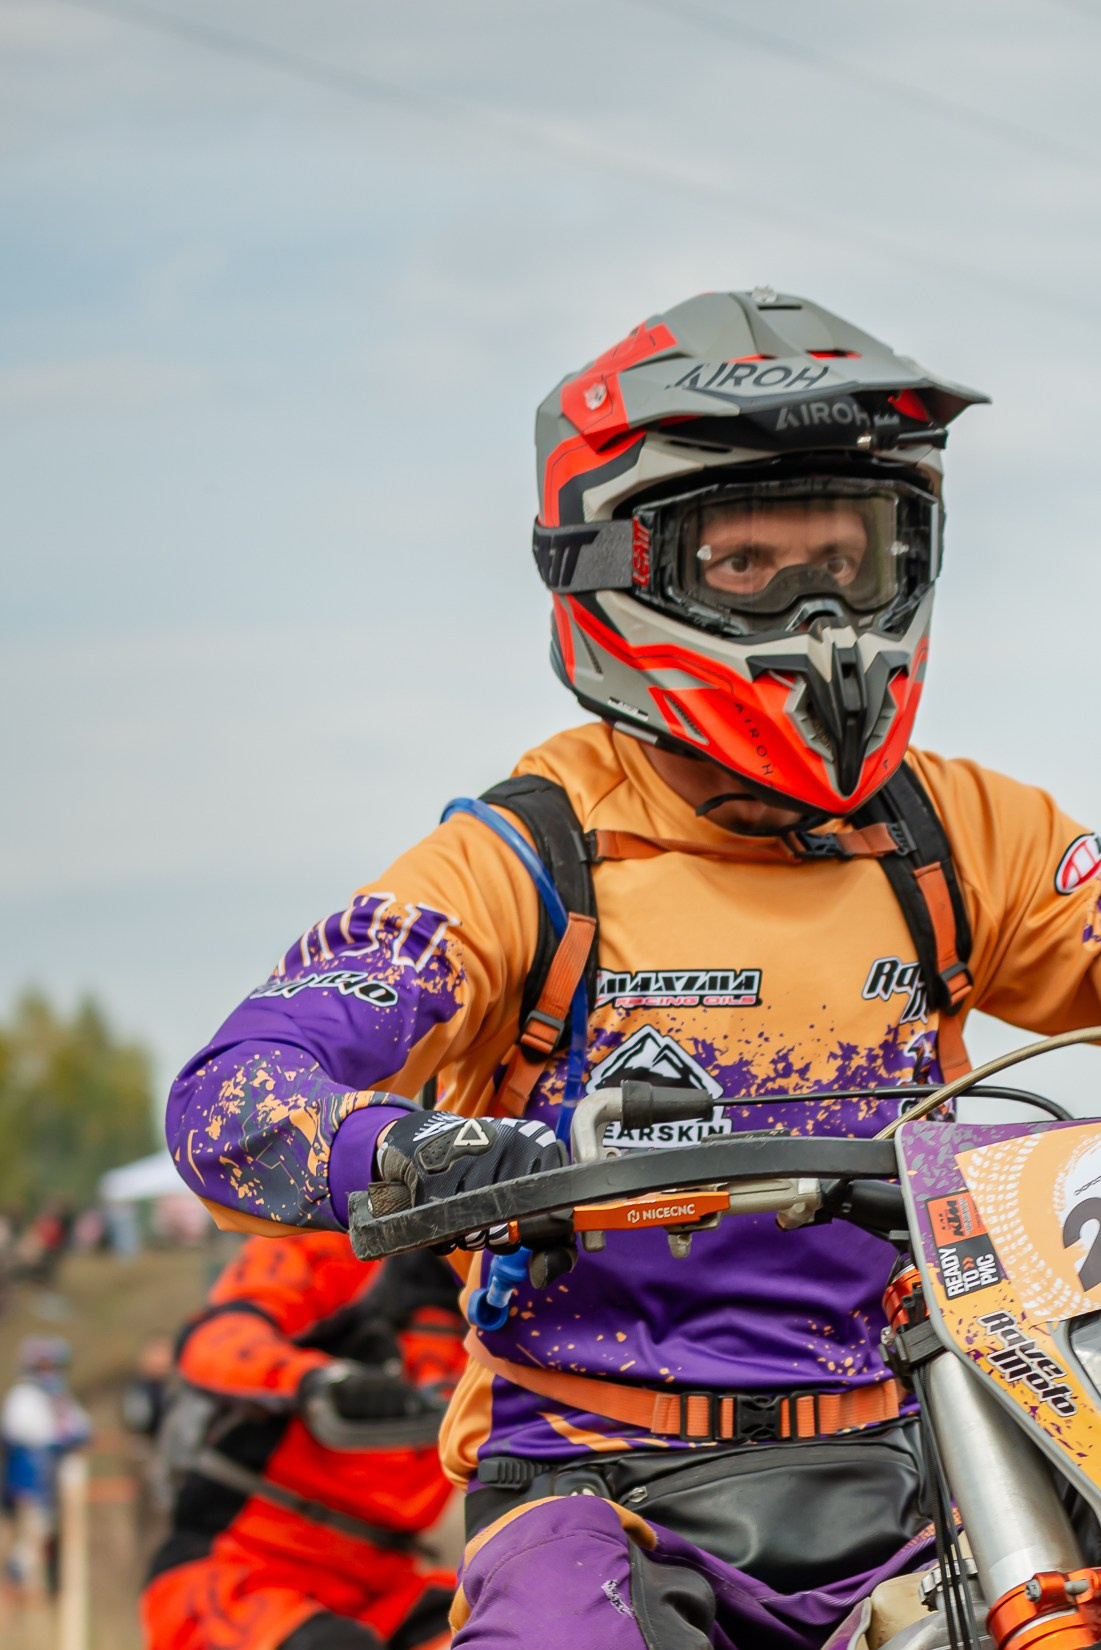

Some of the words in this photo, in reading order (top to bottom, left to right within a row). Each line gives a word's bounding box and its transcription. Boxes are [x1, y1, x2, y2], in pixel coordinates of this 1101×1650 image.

[665, 362, 830, 390] AIROH
[774, 401, 870, 432] AIROH
[734, 702, 775, 776] AIROH
[599, 971, 759, 994] MAXIMA
[614, 995, 700, 1007] RACING
[702, 994, 758, 1006] OILS
[603, 1124, 724, 1143] EARSKIN
[641, 1203, 696, 1221] NICECNC
[938, 1246, 964, 1297] READY
[963, 1268, 980, 1292] TO
[976, 1253, 999, 1286] PMC
